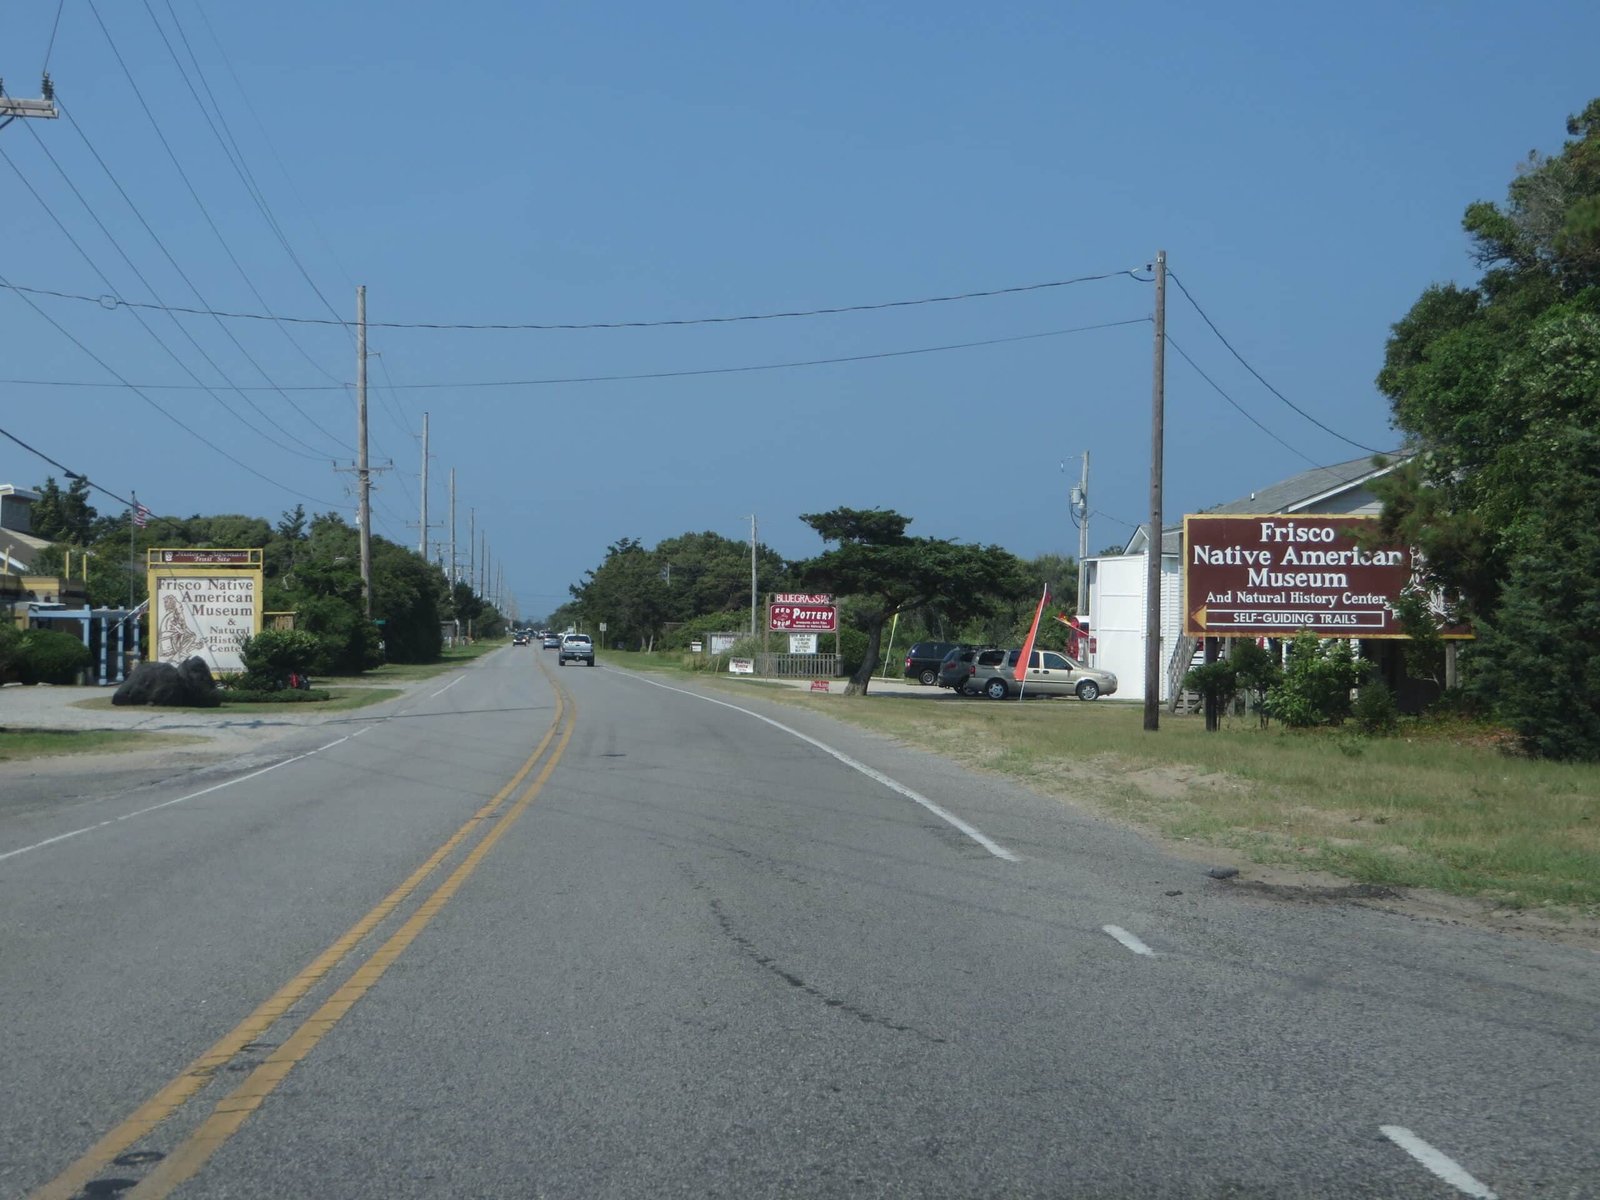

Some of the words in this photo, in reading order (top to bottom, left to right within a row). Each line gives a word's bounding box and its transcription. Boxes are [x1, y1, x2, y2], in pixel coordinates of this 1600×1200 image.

[1259, 522, 1335, 542] Frisco
[1193, 545, 1271, 566] Native
[1280, 545, 1403, 566] American
[1247, 567, 1348, 588] Museum
[157, 578, 202, 590] Frisco
[208, 578, 253, 590] Native
[181, 591, 253, 603] American
[1206, 591, 1232, 603] And
[1237, 592, 1286, 604] Natural
[1290, 592, 1338, 608] History
[1342, 592, 1387, 604] Center
[192, 604, 253, 616] Museum
[227, 618, 236, 626] &
[1233, 612, 1314, 624] SELF-GUIDING
[1320, 613, 1357, 624] TRAILS
[209, 626, 250, 635] Natural
[209, 635, 245, 644] Histo
[208, 645, 242, 653] Cente
